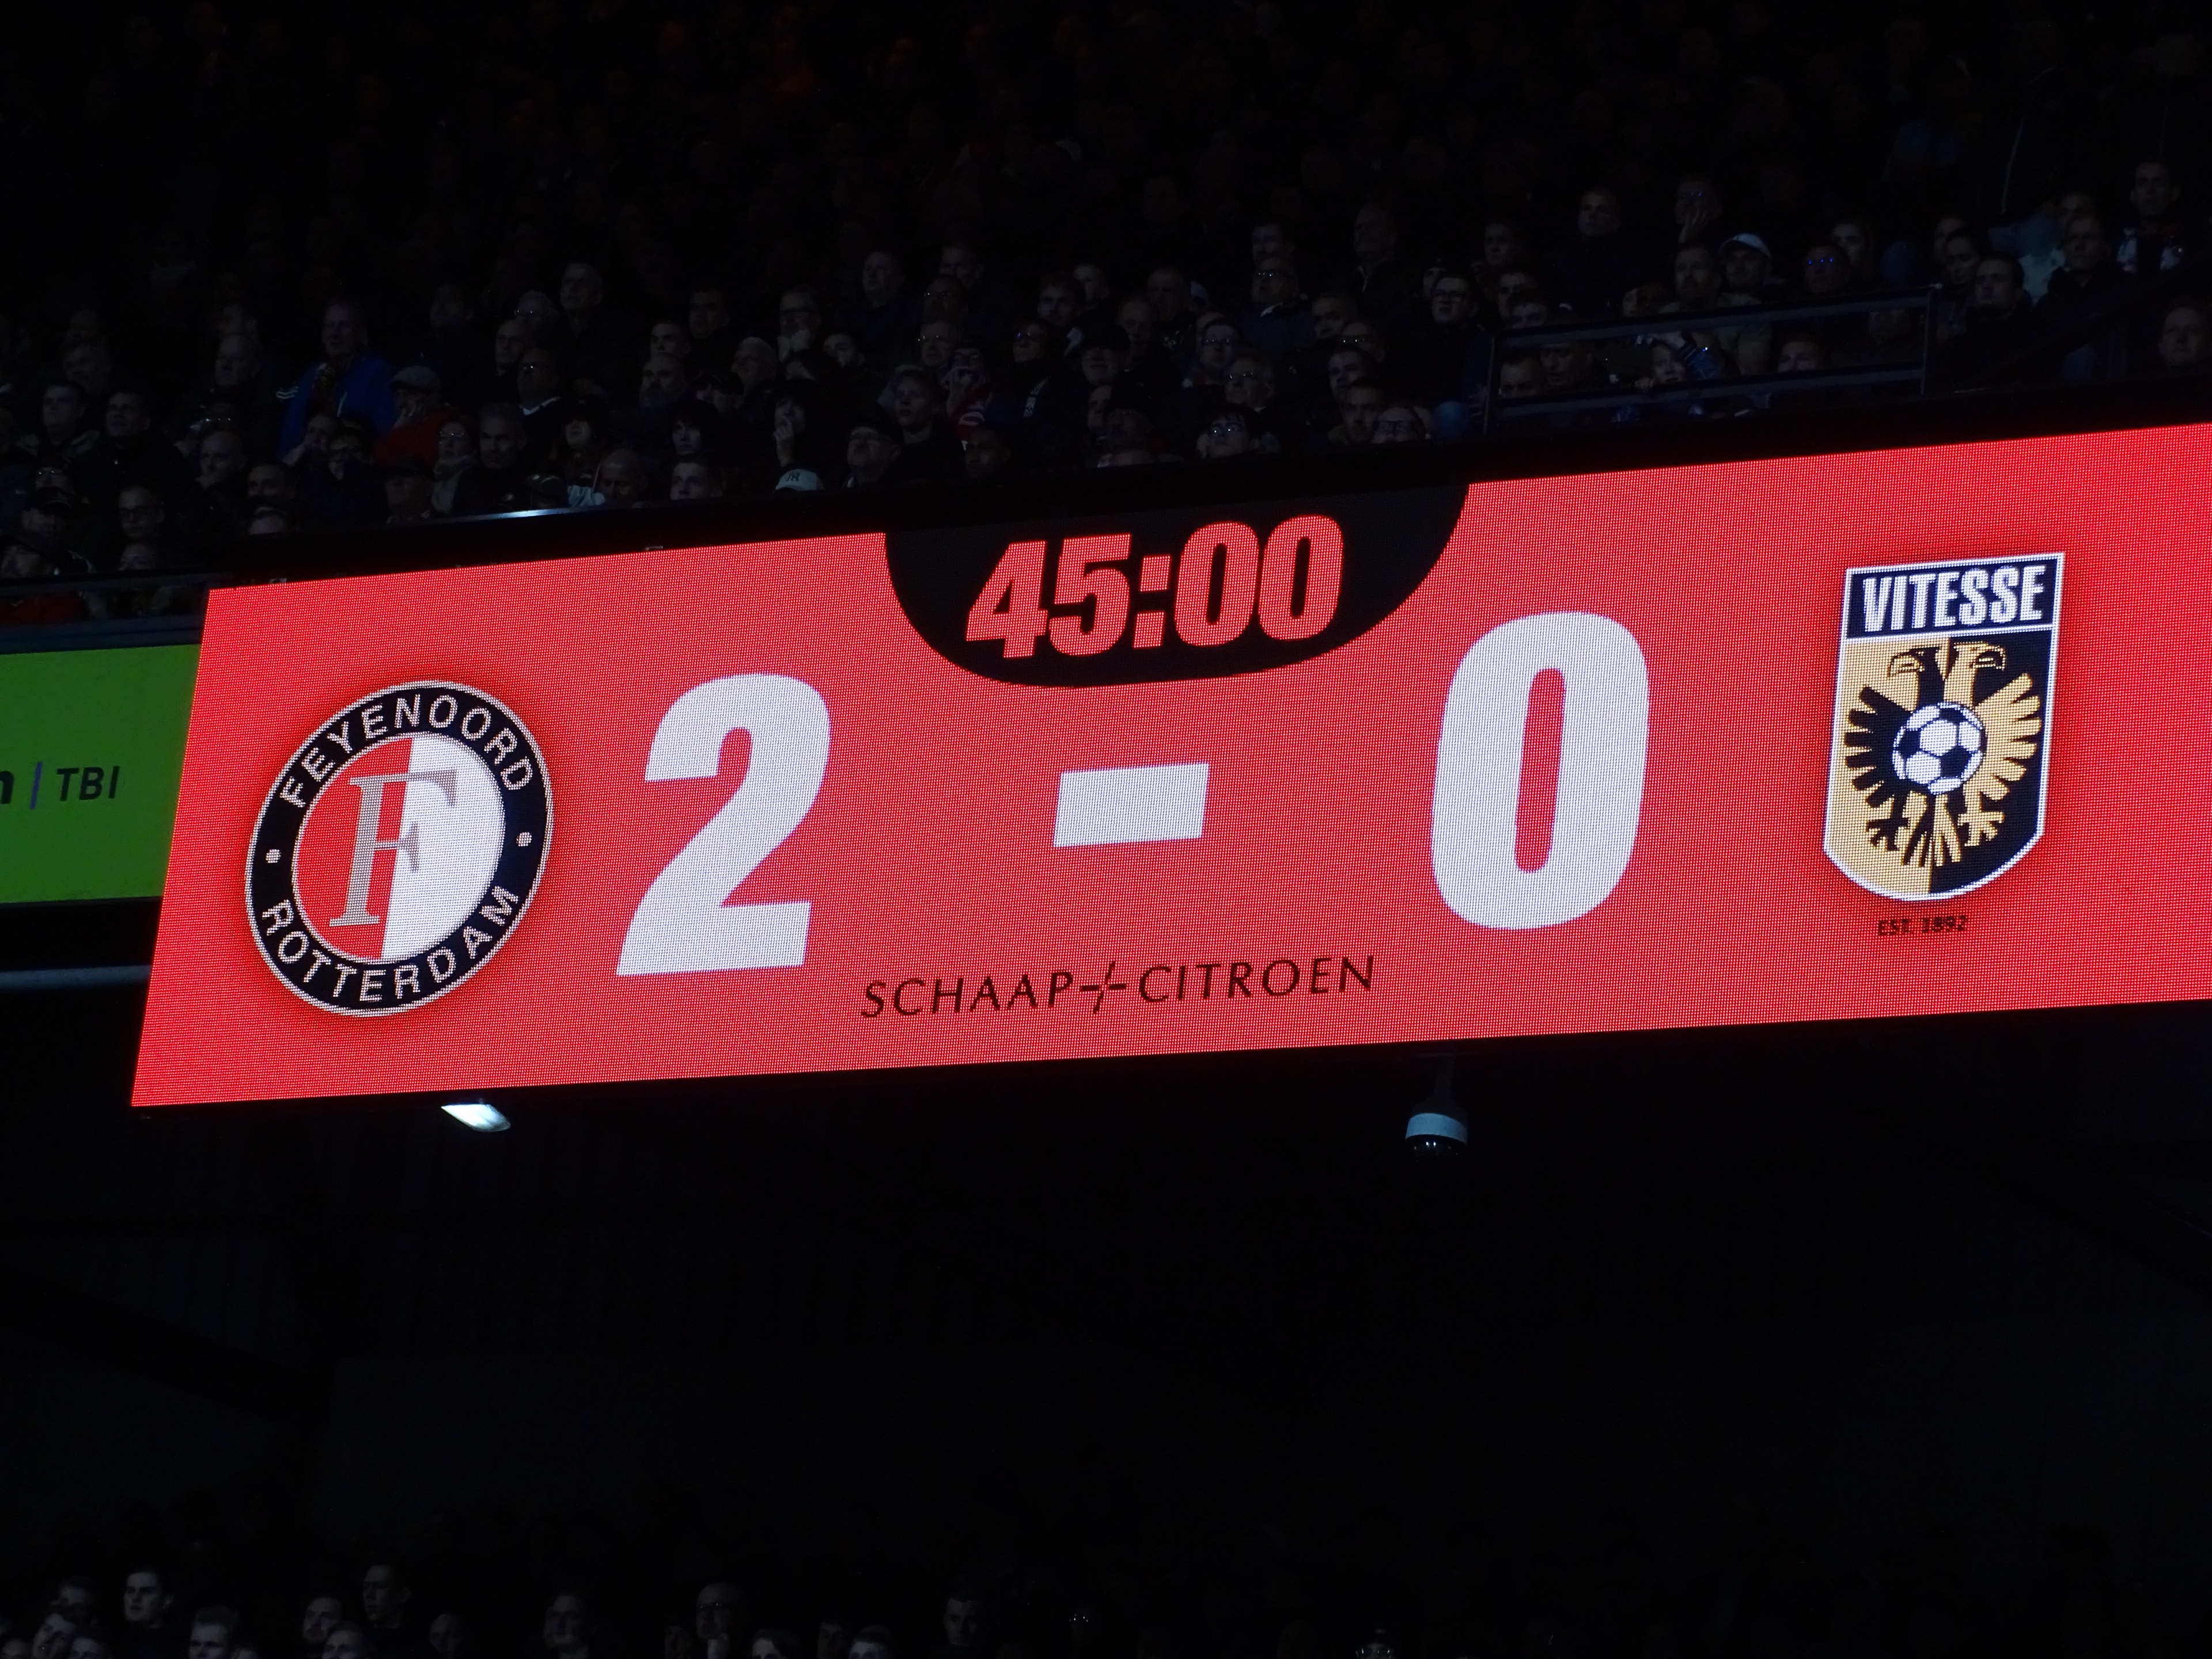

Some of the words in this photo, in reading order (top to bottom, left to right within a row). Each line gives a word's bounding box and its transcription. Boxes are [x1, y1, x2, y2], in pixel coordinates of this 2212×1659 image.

[965, 515, 1344, 658] 45:00
[1862, 565, 2046, 632] VITESSE
[56, 765, 120, 801] TBI
[279, 694, 534, 808] FEYENOORD
[616, 673, 832, 976] 2
[1430, 611, 1650, 930] 0
[262, 885, 520, 1002] ROTTERDAM
